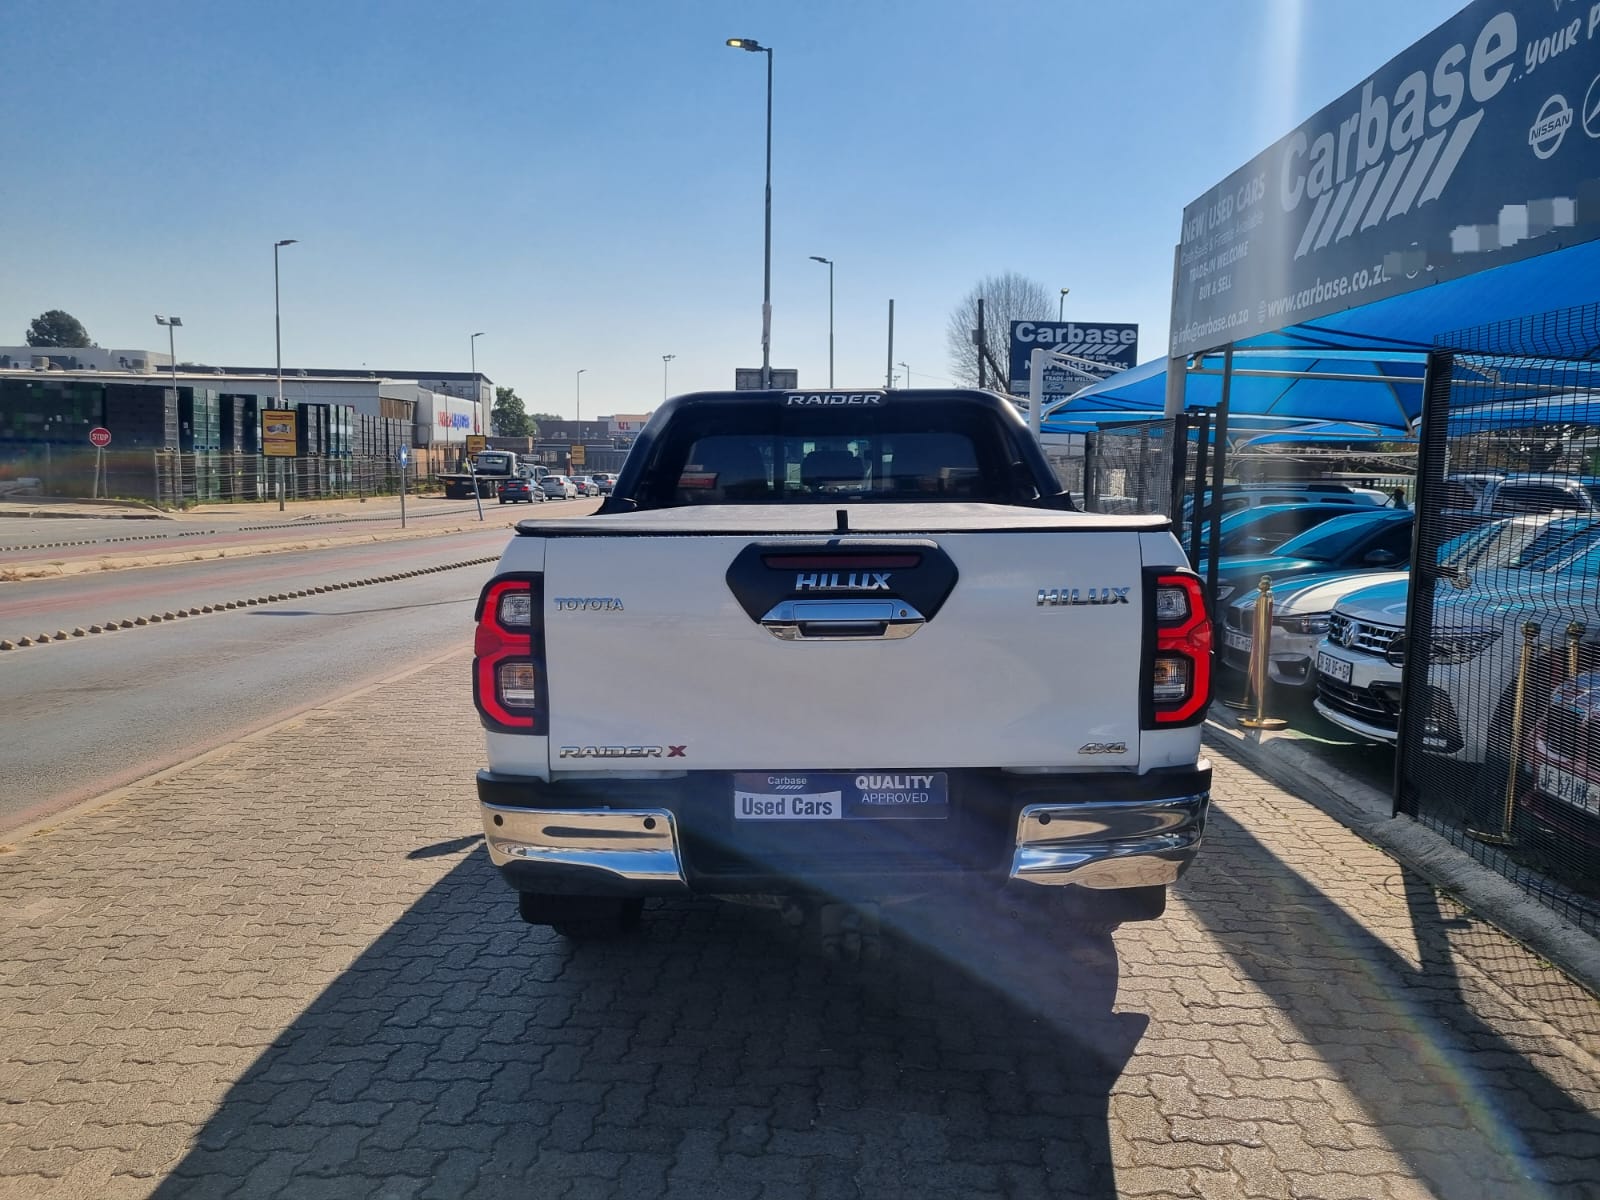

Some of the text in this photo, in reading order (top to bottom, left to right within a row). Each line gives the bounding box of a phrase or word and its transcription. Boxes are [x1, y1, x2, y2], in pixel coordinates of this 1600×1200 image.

[1280, 11, 1518, 212] Carbase
[1531, 113, 1570, 140] NISSAN
[1183, 172, 1265, 245] NEW USED CARS
[1189, 240, 1249, 283] TRADE-IN WELCOME
[1199, 282, 1212, 301] BUY
[1217, 274, 1232, 293] SELL
[1015, 322, 1137, 344] Carbase
[787, 394, 881, 405] RAIDER
[92, 433, 109, 441] STOP
[795, 573, 892, 591] HILUX
[554, 597, 624, 611] TOYOTA
[1037, 587, 1130, 606] HILUX
[559, 745, 687, 759] RAIDER X
[1078, 742, 1128, 754] 4X4
[767, 776, 807, 785] Carbase
[855, 775, 934, 790] QUALITY
[742, 797, 833, 816] Used Cars
[861, 793, 929, 803] APPROVED
